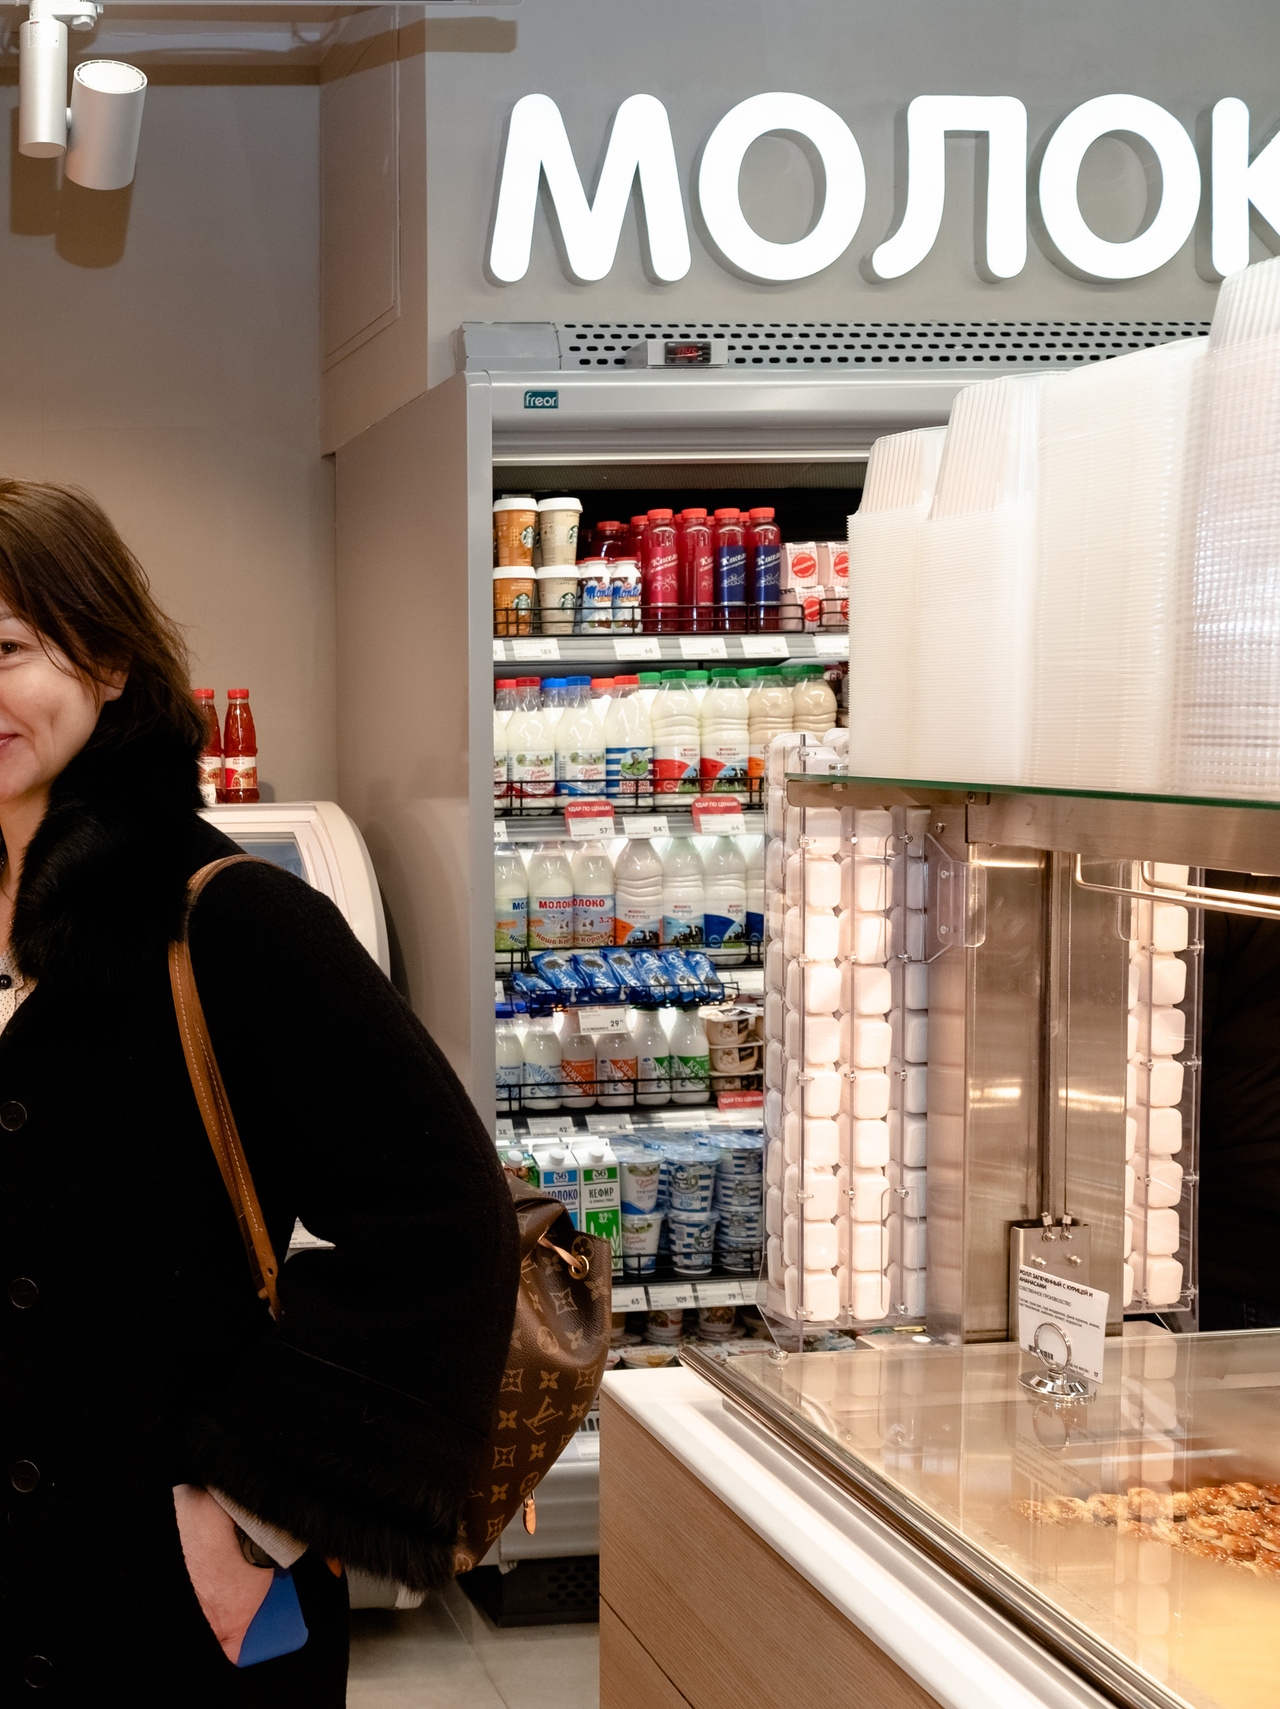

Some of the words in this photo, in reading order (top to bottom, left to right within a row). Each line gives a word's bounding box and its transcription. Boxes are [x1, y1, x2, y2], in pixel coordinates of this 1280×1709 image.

[525, 392, 557, 407] freor
[572, 899, 605, 908] ОЛОКО
[536, 932, 557, 945] Наша
[581, 932, 609, 944] Корова
[555, 1172, 567, 1180] 36
[594, 1168, 606, 1177] 36
[589, 1187, 614, 1198] КЕФИР
[1019, 1276, 1047, 1290] АНАНАСАМИ
[1020, 1269, 1032, 1278] РОЛЛ
[1032, 1272, 1061, 1287] ЗАПЕЧЕННЫЙ
[1067, 1285, 1089, 1296] КУРИЦЕЙ
[1019, 1285, 1042, 1297] СОБСТВЕННОЕ
[1043, 1293, 1071, 1307] ПРОИЗВОДСТВО
